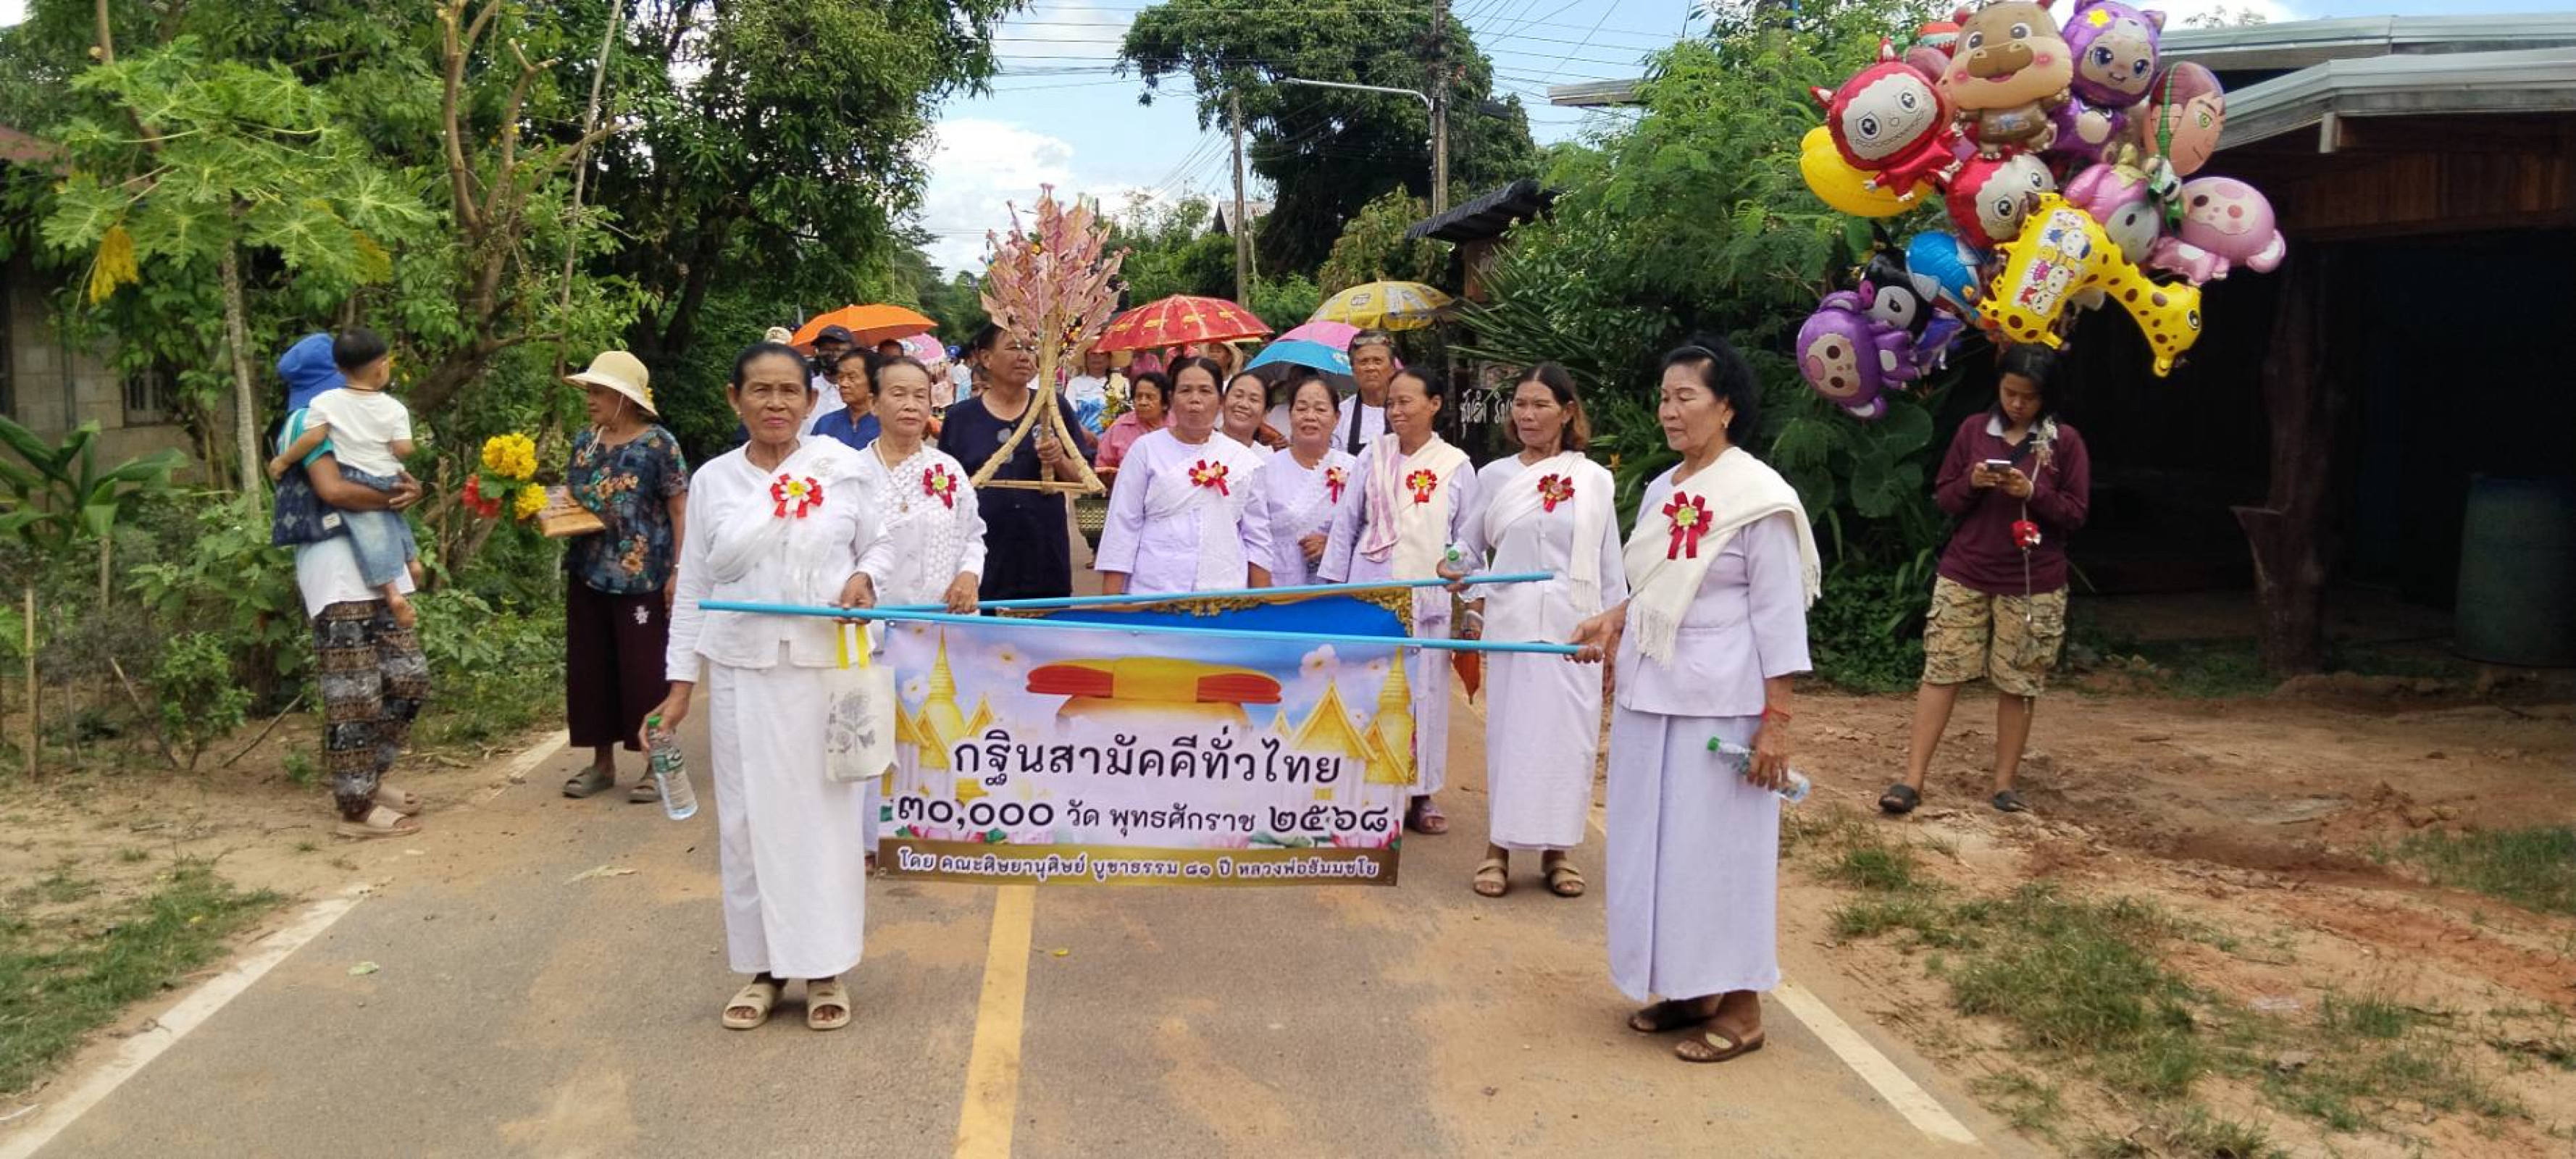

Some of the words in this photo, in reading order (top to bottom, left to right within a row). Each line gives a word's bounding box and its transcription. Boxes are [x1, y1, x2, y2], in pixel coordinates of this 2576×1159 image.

[954, 726, 1340, 786] กฐินสามัคคีทั่วไทย
[898, 796, 1054, 830] ๓๐,๐๐๐
[1067, 799, 1099, 827] วัด
[1110, 802, 1255, 837] พุทธศักราช
[1269, 804, 1389, 832] ๒๕๖๘
[899, 848, 934, 869] โดย
[1219, 858, 1231, 875] ปี
